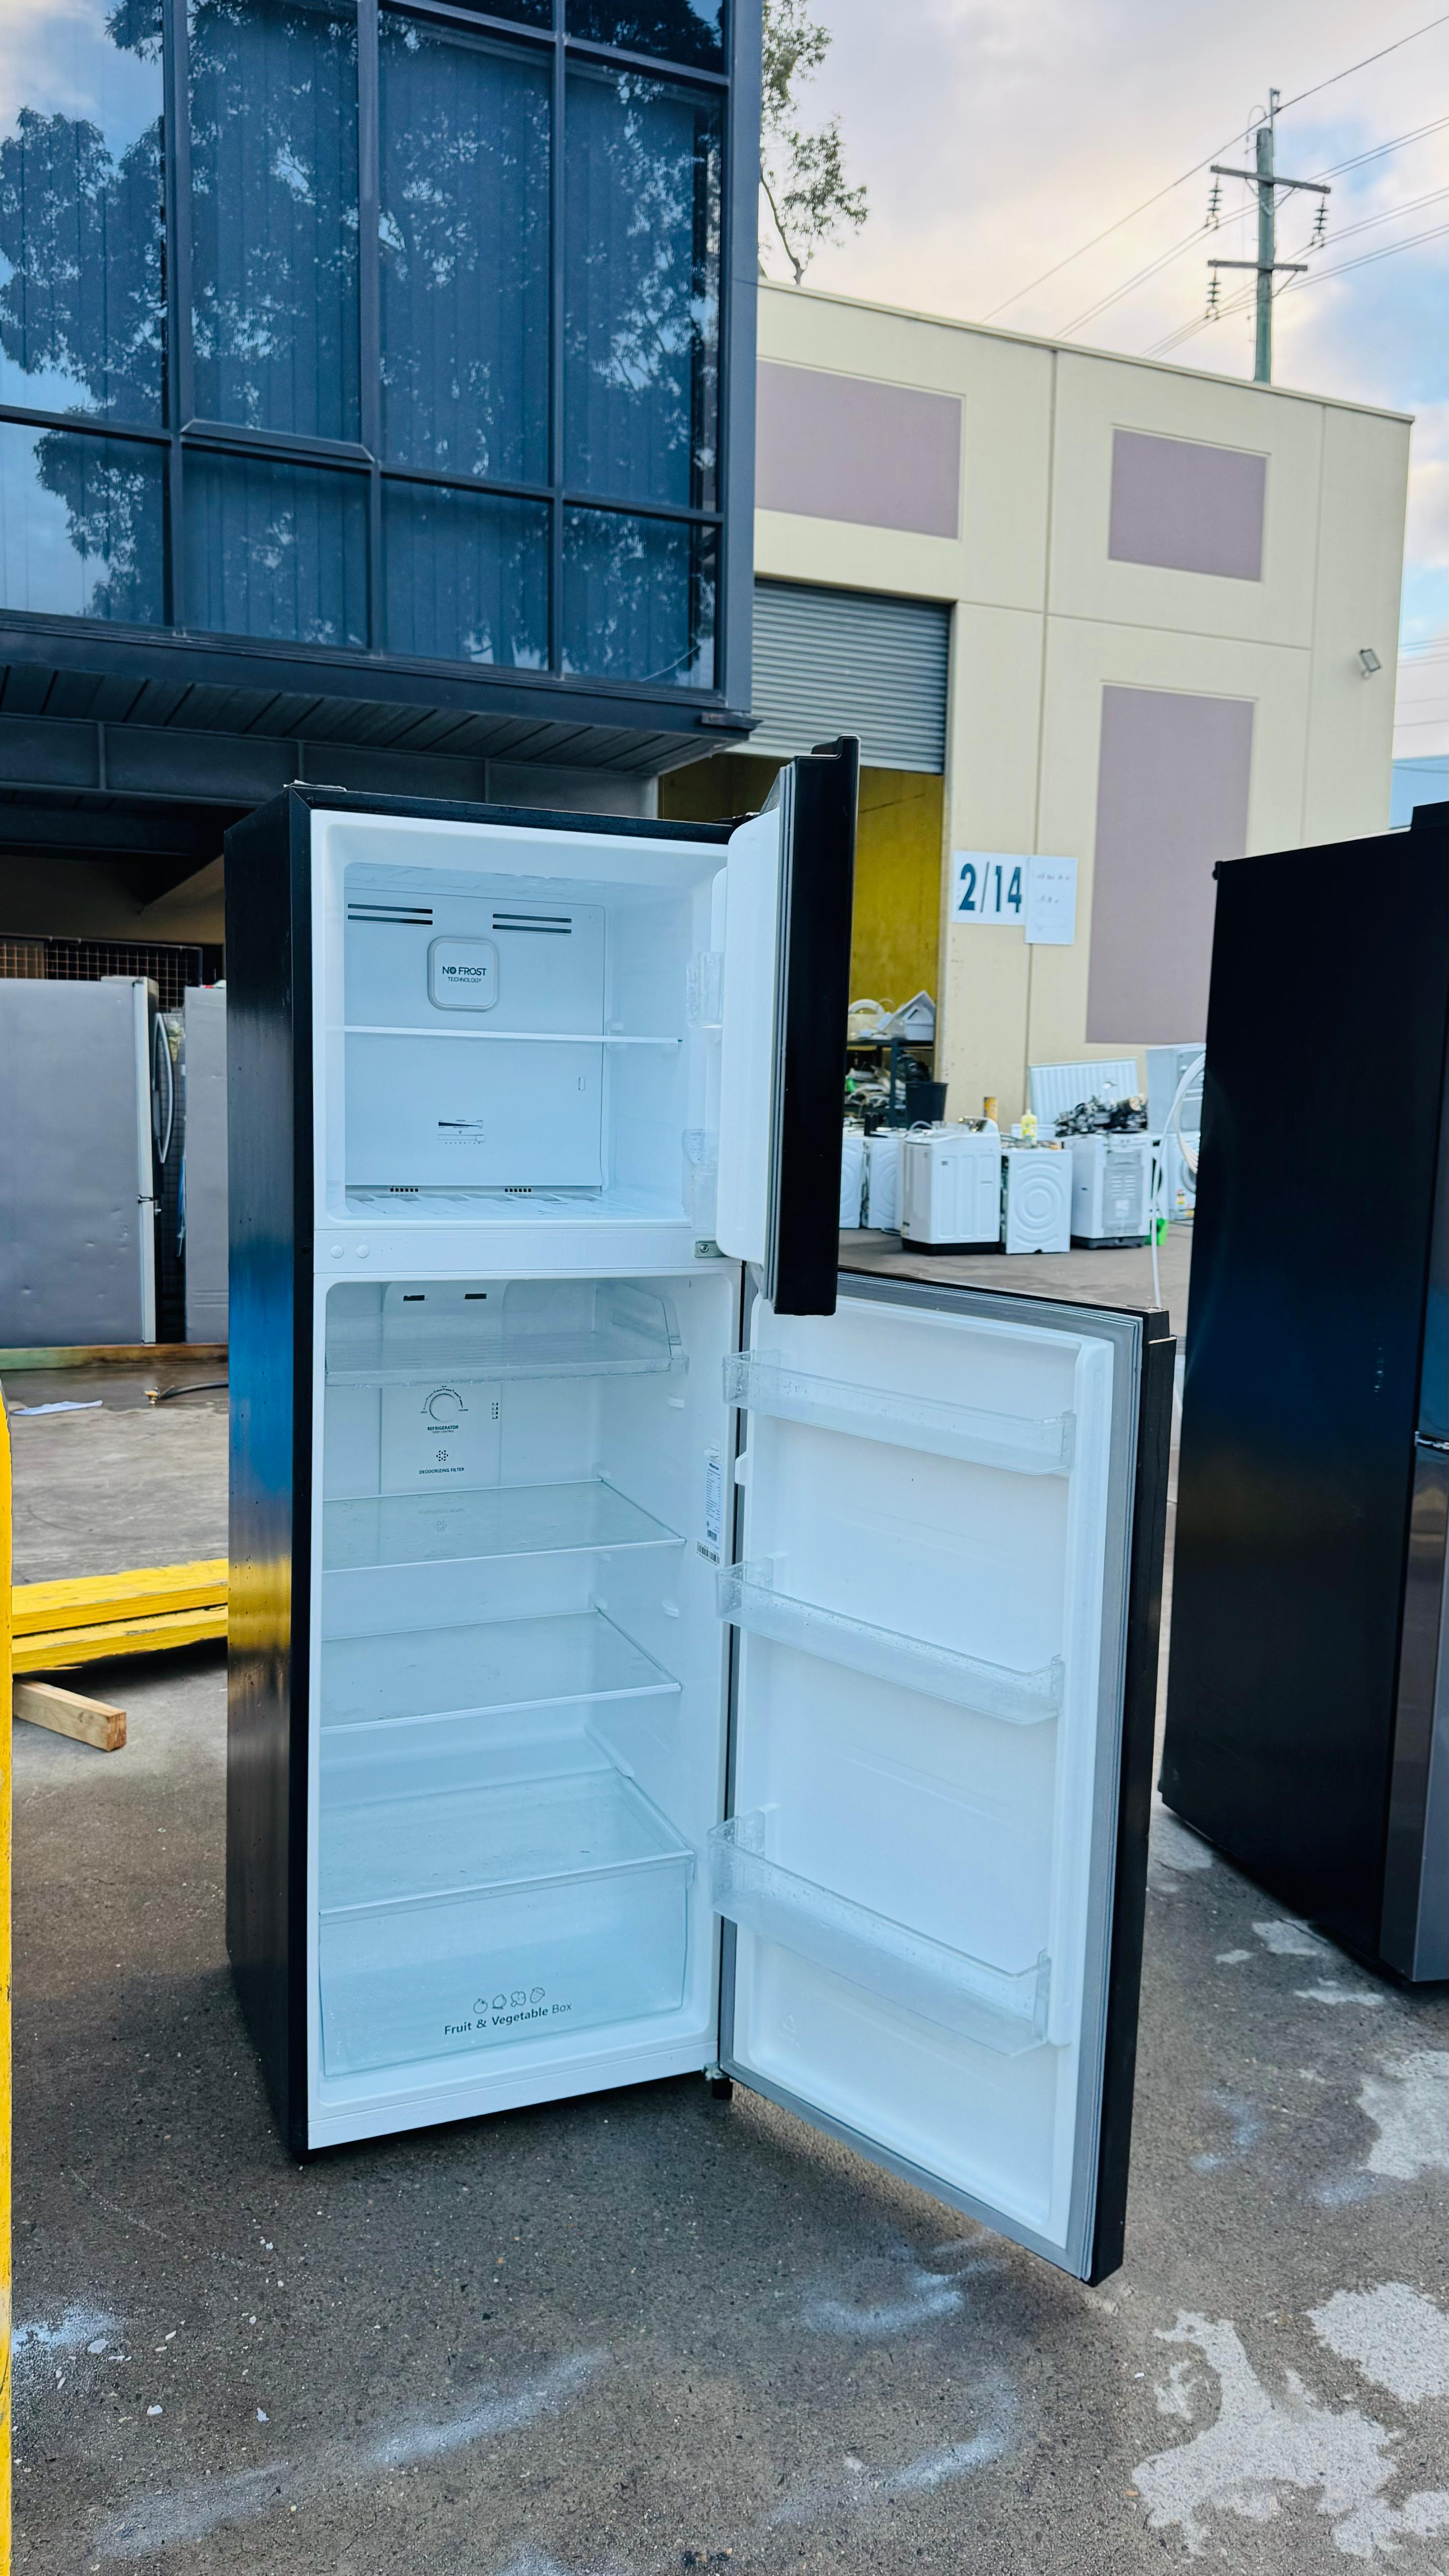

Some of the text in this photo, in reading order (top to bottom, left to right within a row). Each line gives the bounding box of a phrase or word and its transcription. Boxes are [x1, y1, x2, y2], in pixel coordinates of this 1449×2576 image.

[958, 861, 1022, 913] 2/14
[442, 966, 487, 976] NO FROST
[445, 2003, 573, 2035] Fruit & Vegetable Box
